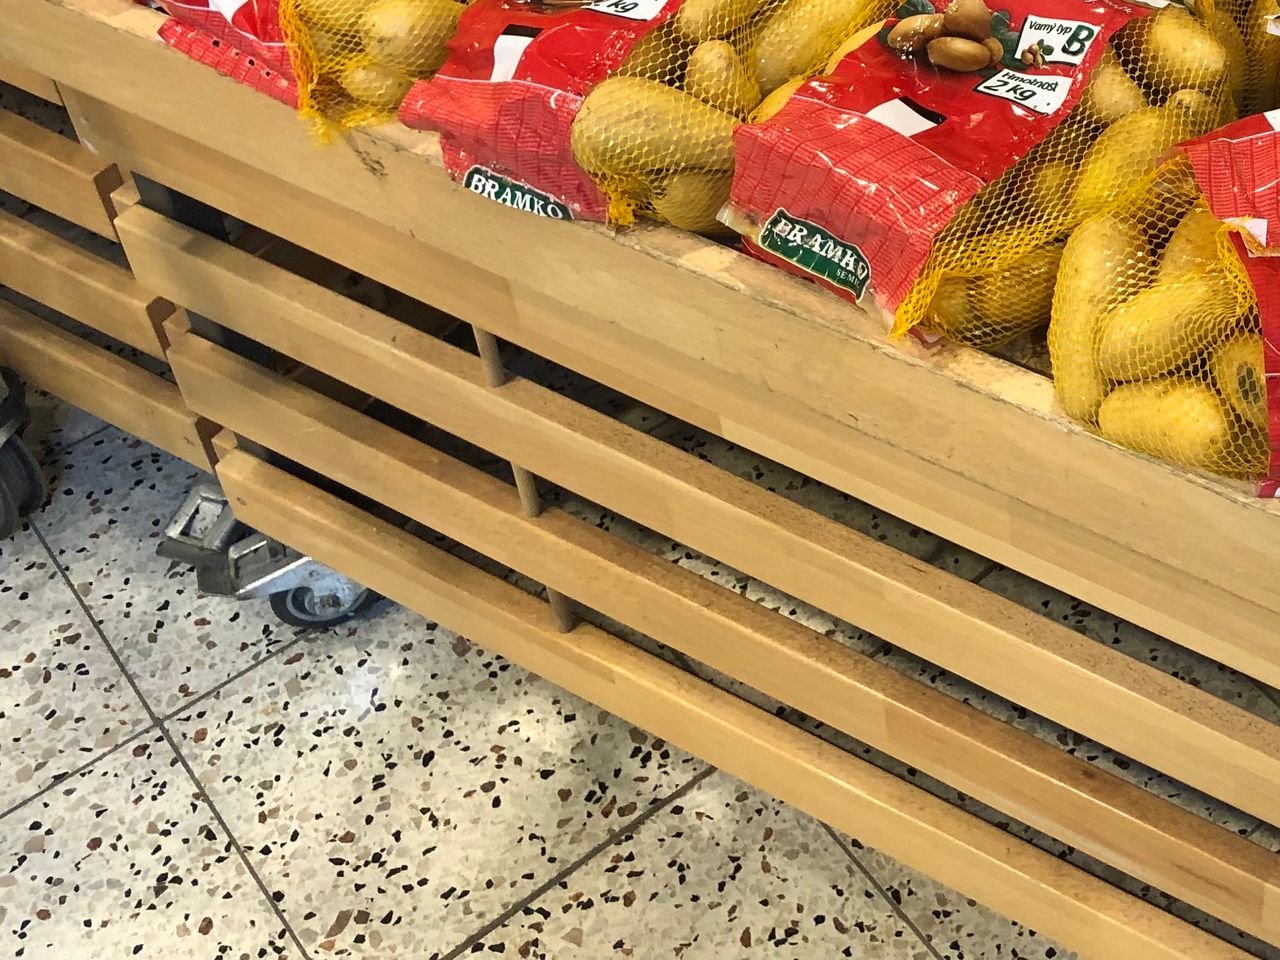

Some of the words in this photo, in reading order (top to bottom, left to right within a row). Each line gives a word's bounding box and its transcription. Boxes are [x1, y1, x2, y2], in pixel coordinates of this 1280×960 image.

[1028, 20, 1056, 32] Varný
[1055, 24, 1073, 36] typ
[1061, 24, 1096, 58] B
[983, 79, 1003, 93] 2
[1004, 84, 1038, 103] kg
[1002, 71, 1059, 93] Hmotnost
[468, 172, 564, 220] BRAMKO
[771, 216, 868, 281] BRAMKO
